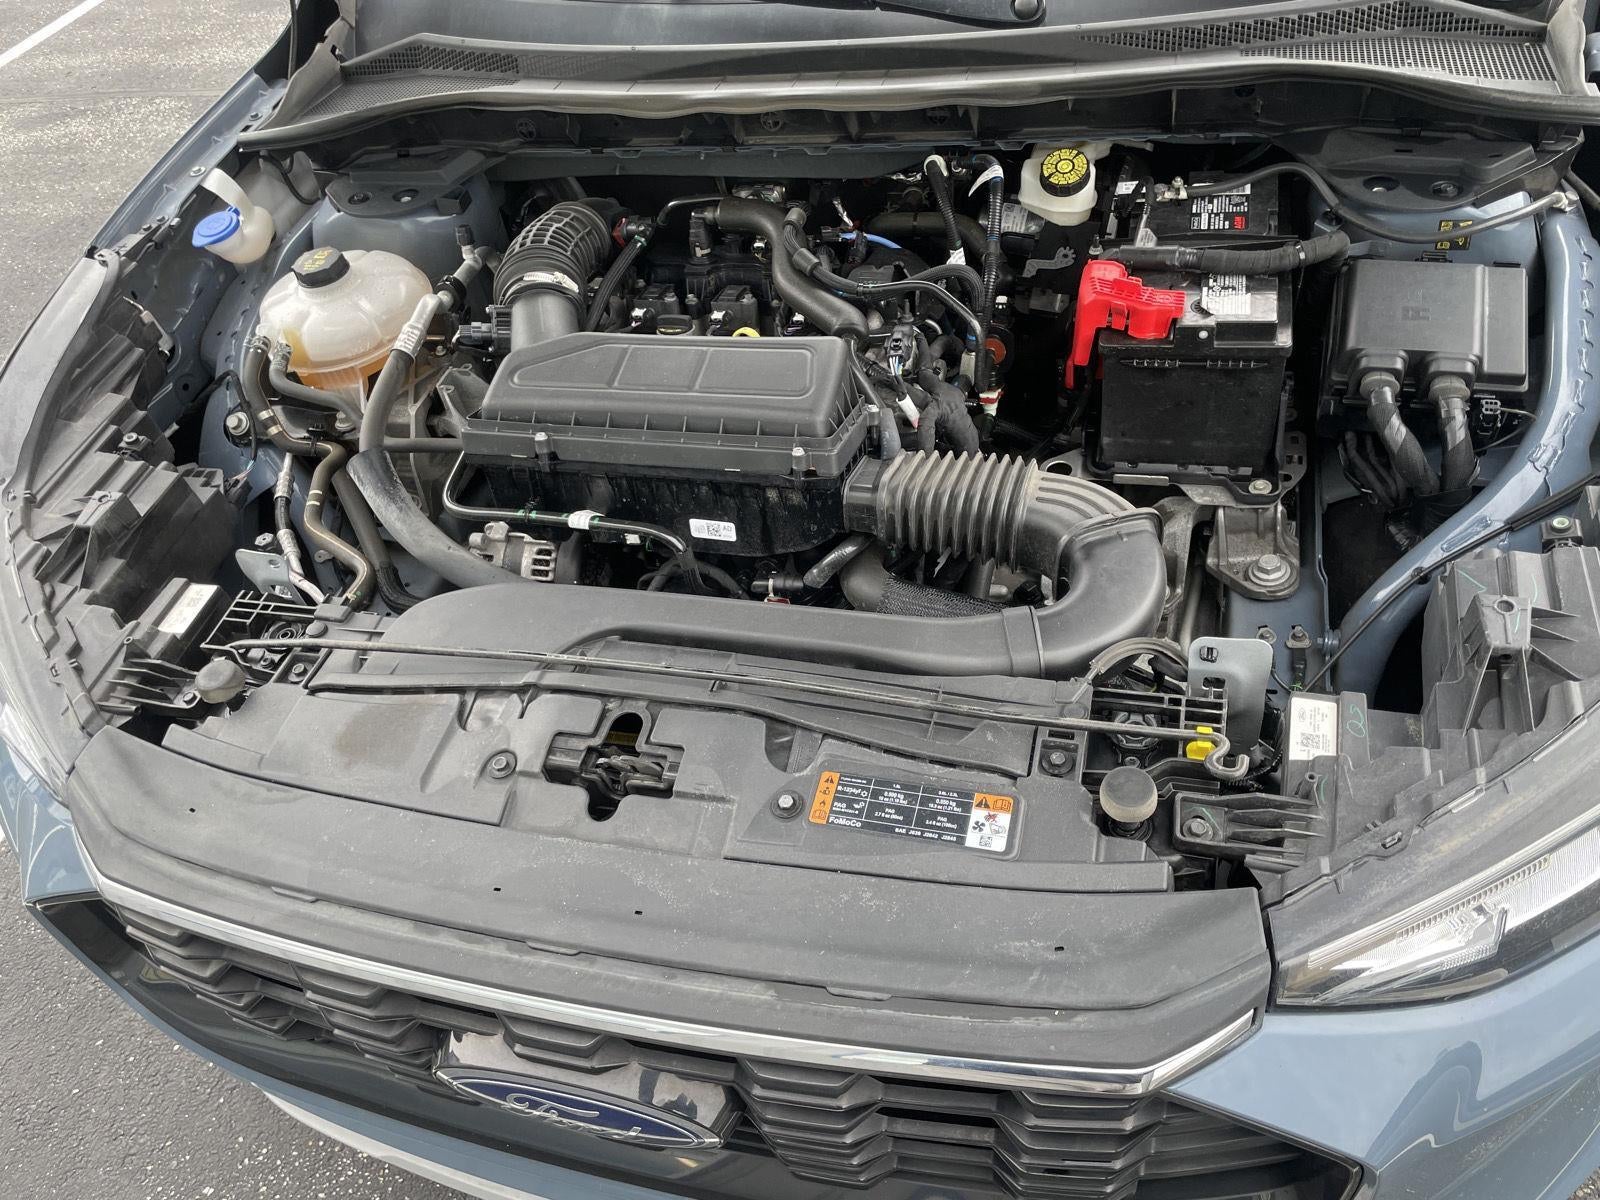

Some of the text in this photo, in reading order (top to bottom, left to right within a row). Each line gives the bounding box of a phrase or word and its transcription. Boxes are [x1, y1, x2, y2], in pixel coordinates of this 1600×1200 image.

[837, 786, 861, 794] R-1234yf
[829, 817, 862, 827] FoMoCo
[500, 1093, 647, 1142] Ford
